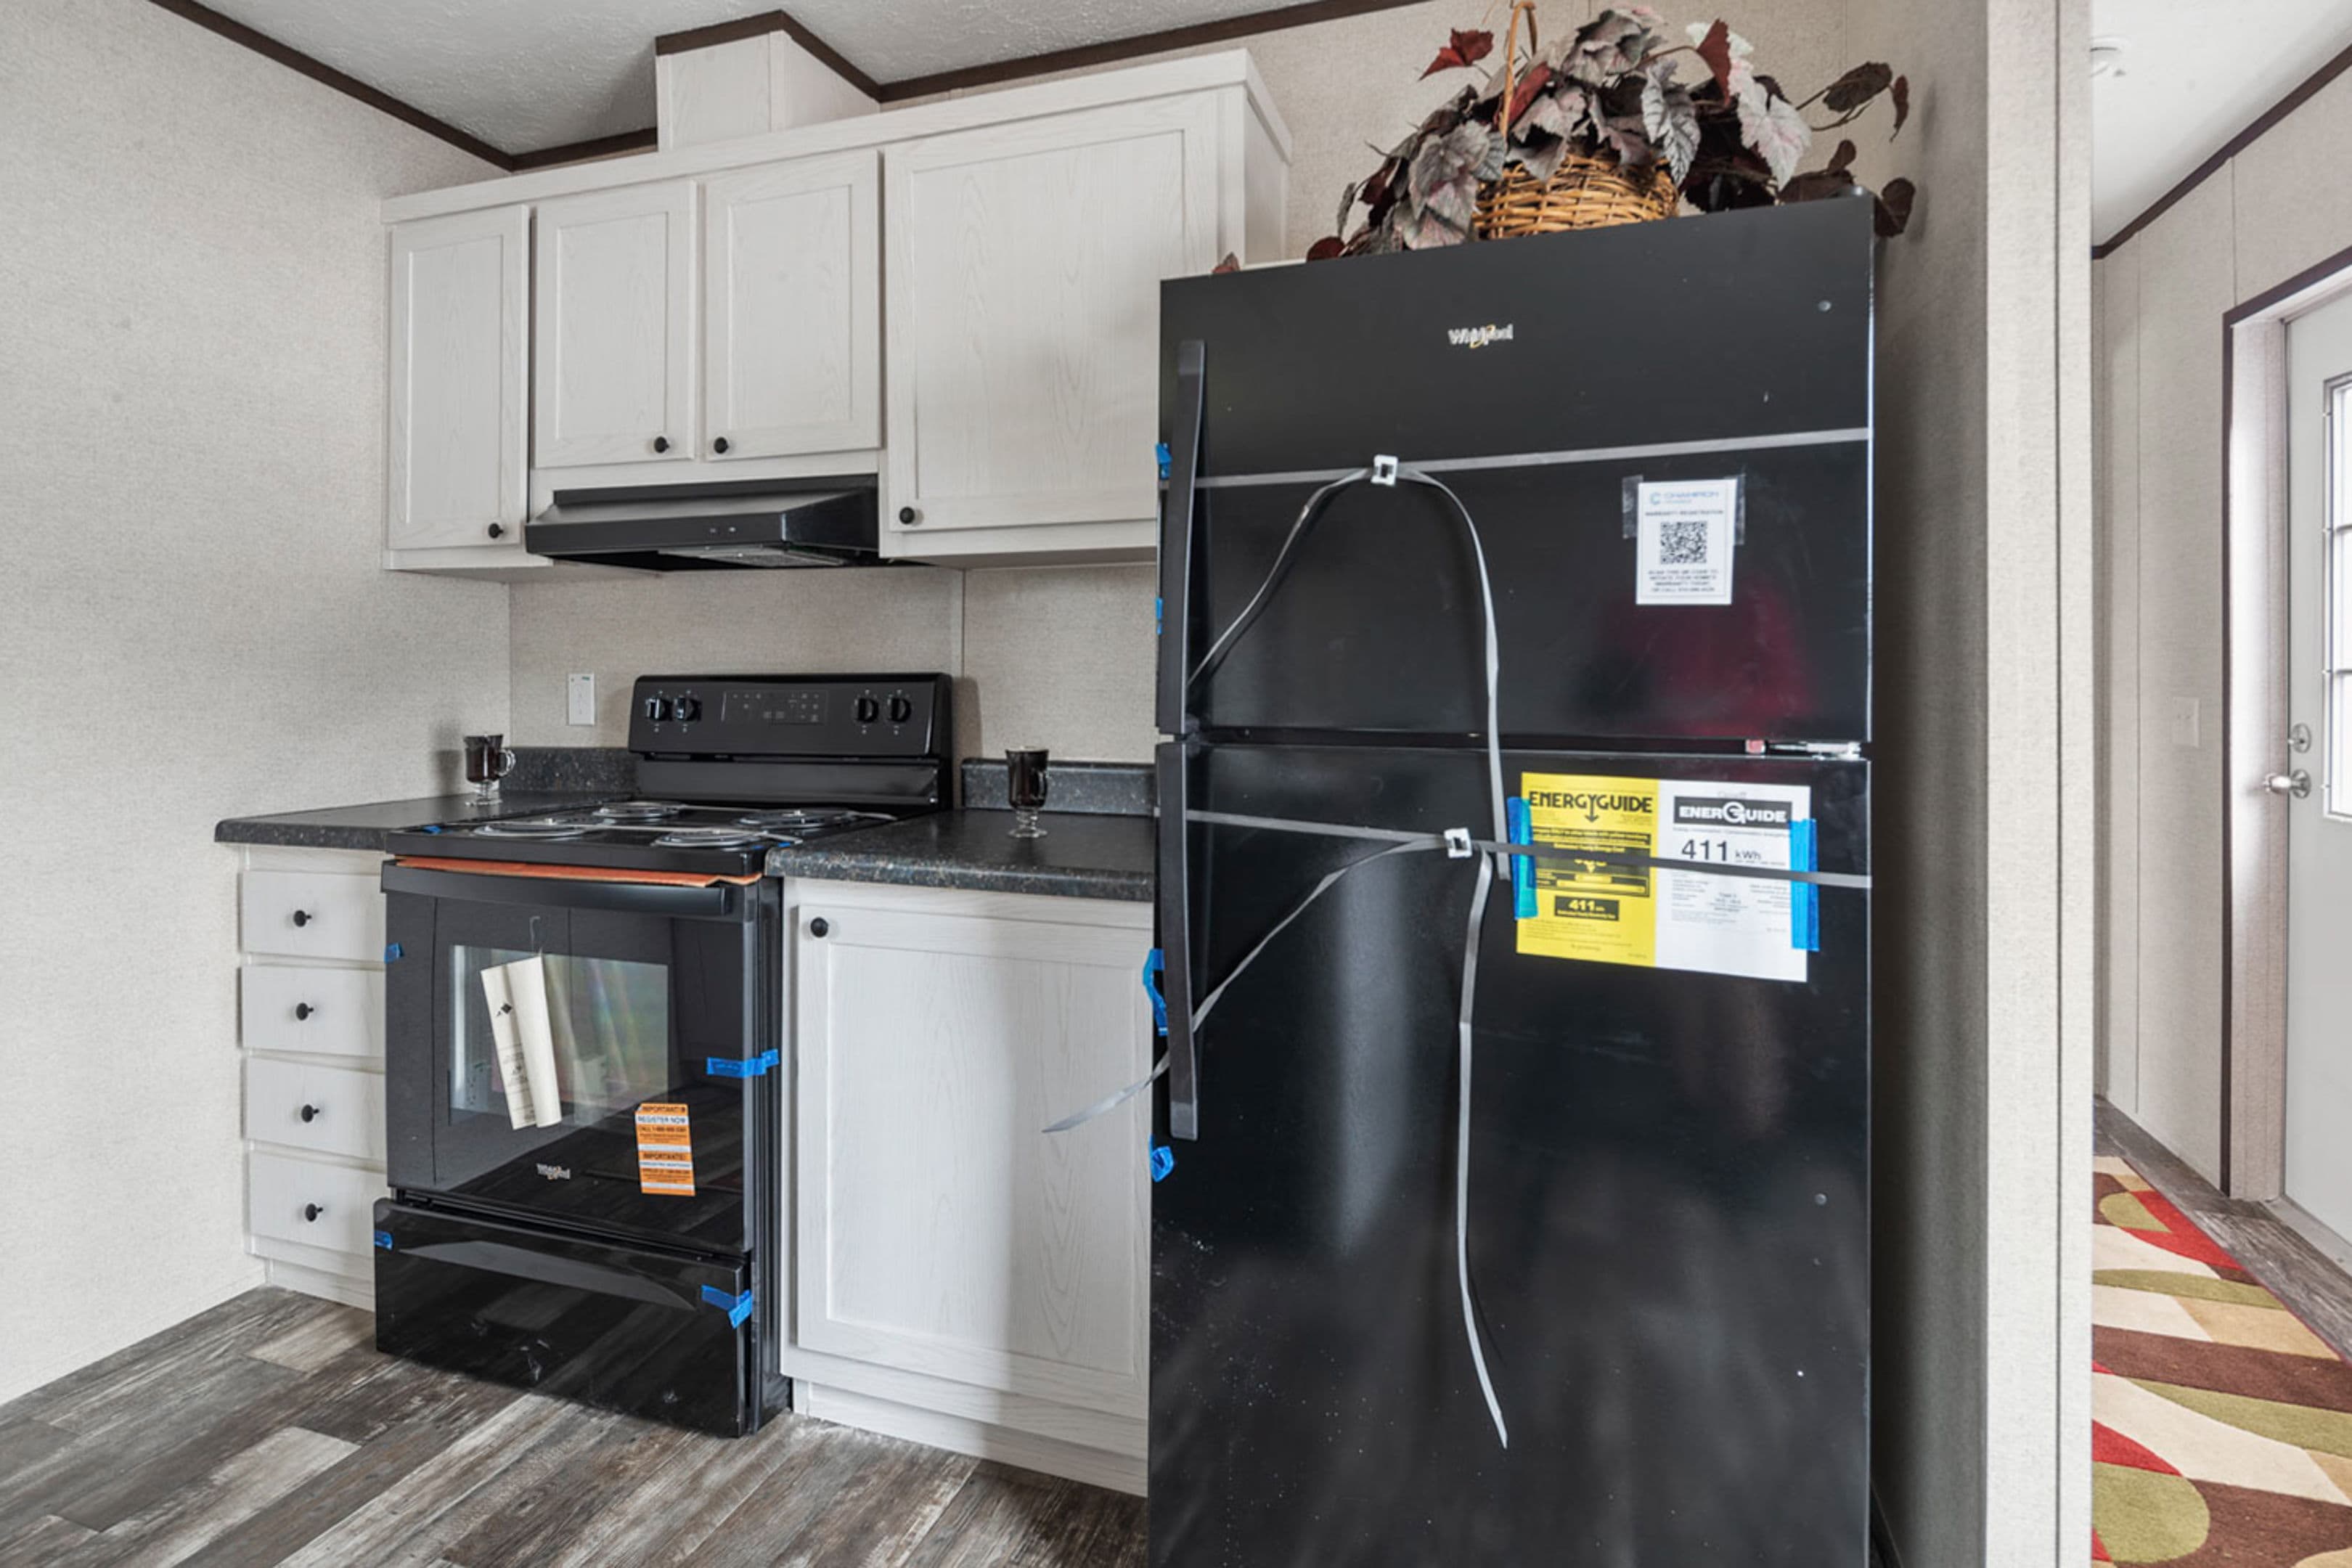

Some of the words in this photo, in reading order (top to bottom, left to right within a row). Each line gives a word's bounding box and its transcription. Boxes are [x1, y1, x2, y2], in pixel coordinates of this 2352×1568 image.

[1529, 791, 1653, 813] ENERGYGUIDE
[1681, 838, 1728, 862] 411
[1735, 849, 1761, 860] kWh
[1568, 899, 1596, 911] 411
